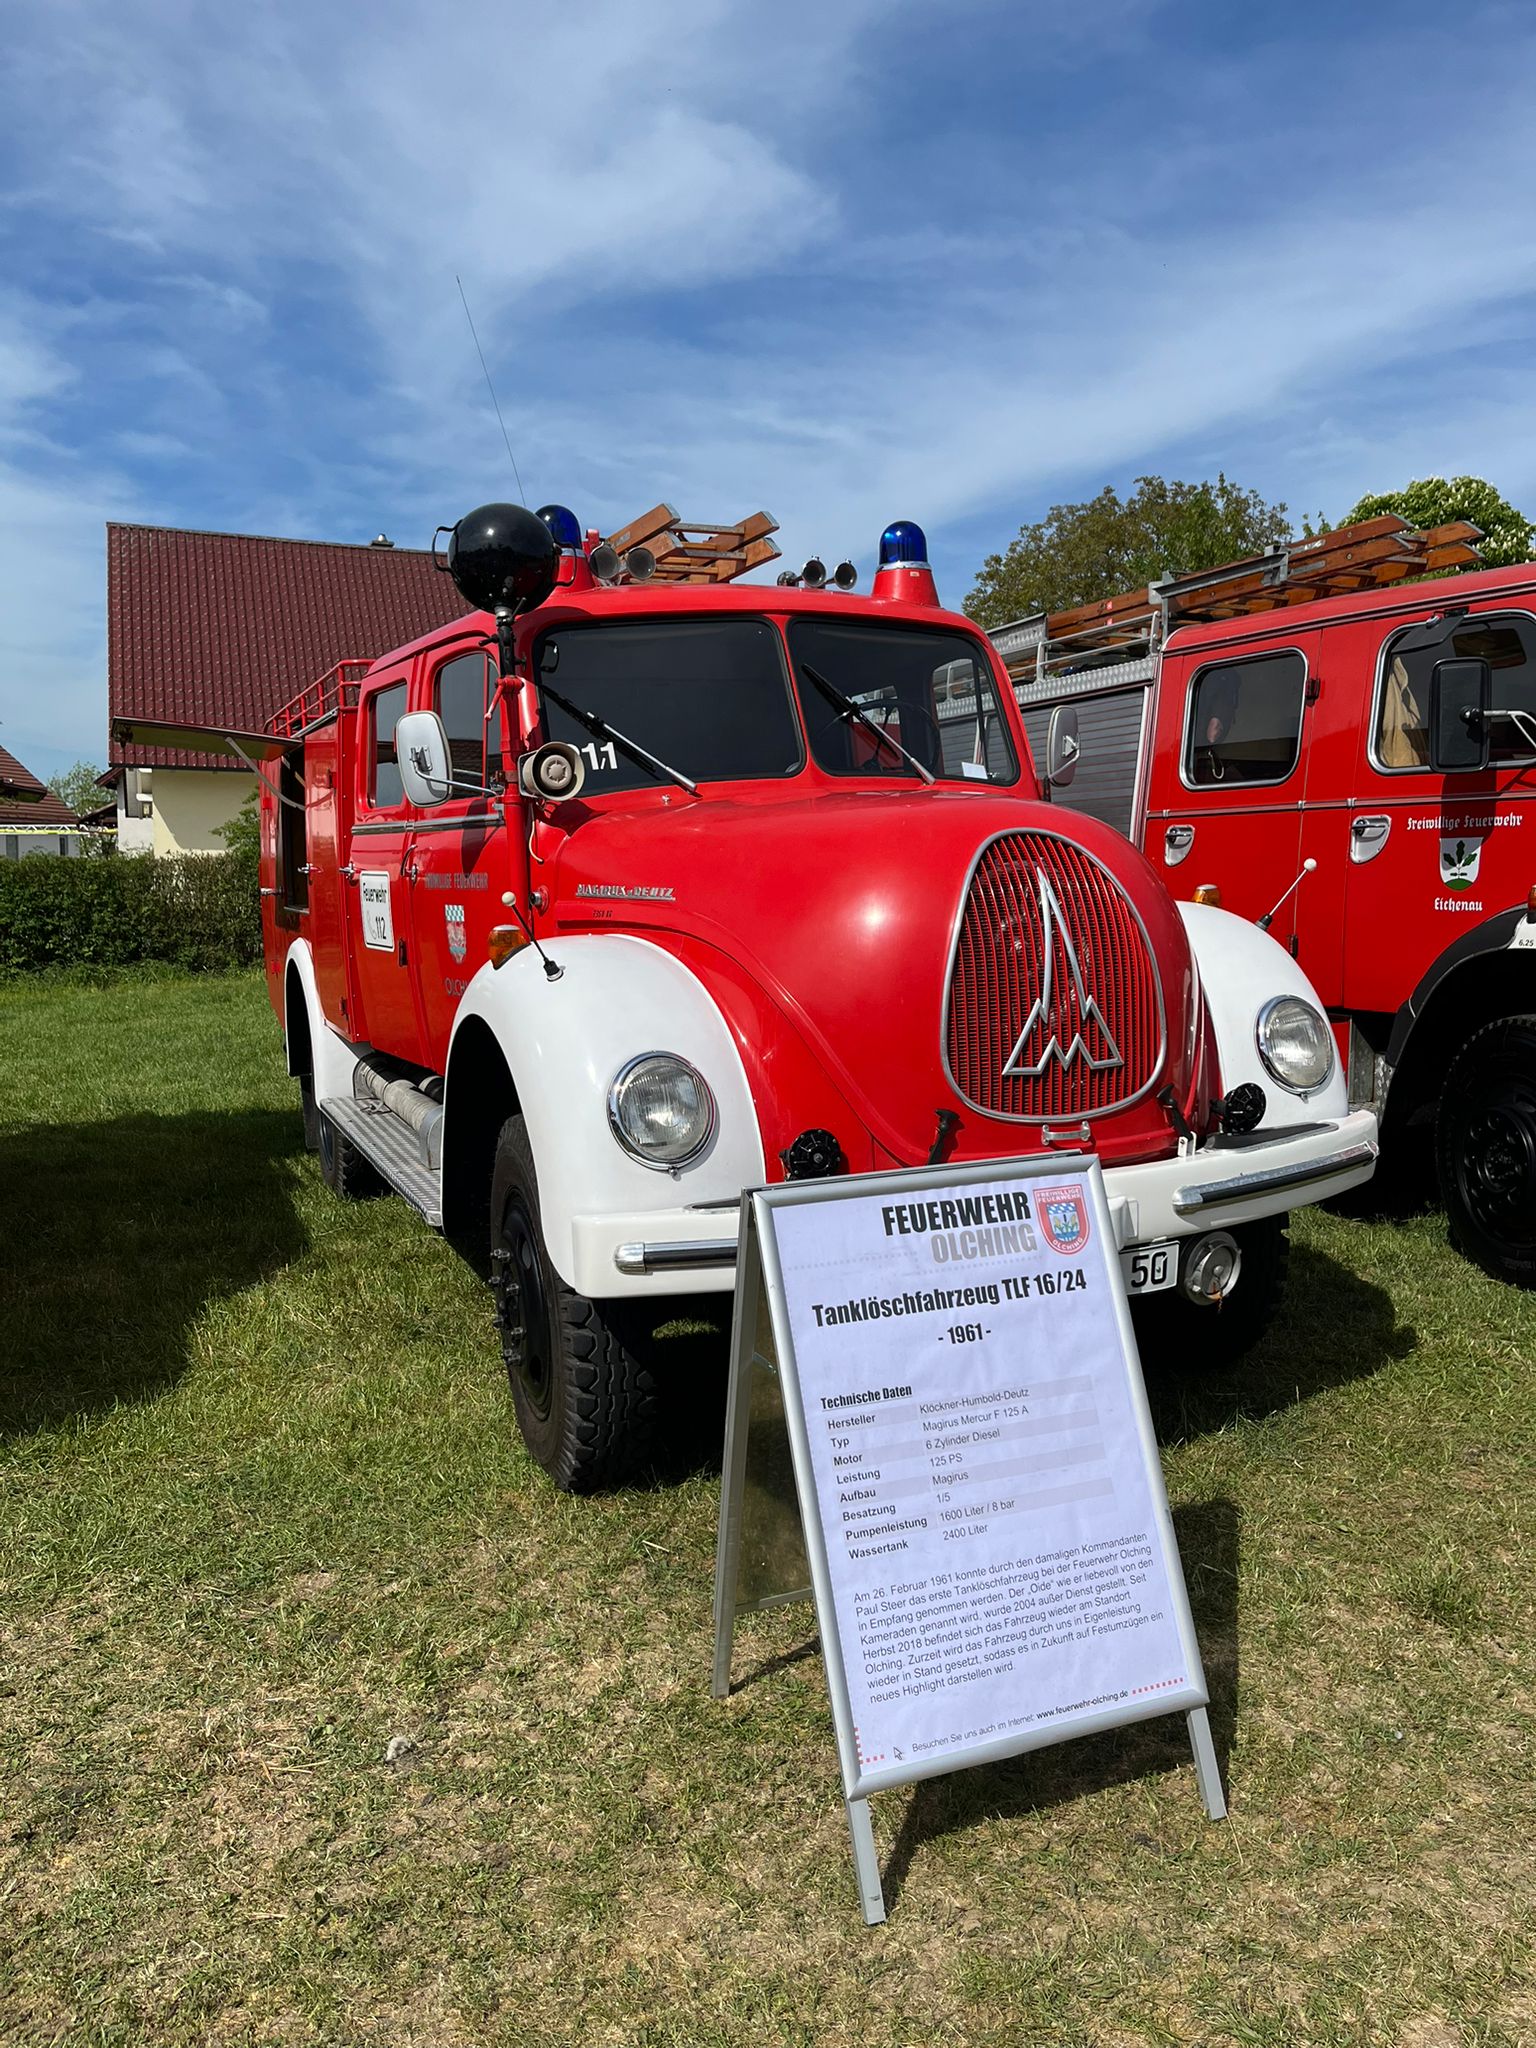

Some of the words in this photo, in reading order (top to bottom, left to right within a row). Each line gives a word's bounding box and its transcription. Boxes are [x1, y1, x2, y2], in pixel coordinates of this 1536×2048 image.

[362, 882, 388, 903] Feuerwehr
[1434, 897, 1483, 912] Eichenau
[375, 915, 387, 940] 112
[881, 1191, 1031, 1236] FEUERWEHR
[930, 1223, 1037, 1263] OLCHING
[1130, 1251, 1168, 1288] 50
[811, 1283, 1000, 1327] Tanklöschfahrzeug
[1001, 1276, 1030, 1300] TLF
[1032, 1268, 1087, 1295] 16/24
[946, 1322, 983, 1344] 1961
[820, 1390, 881, 1409] Technische
[882, 1385, 912, 1399] Daten
[919, 1388, 1029, 1414] Klöckner-Humbold-Deutz
[827, 1414, 875, 1429] Hersteller
[922, 1418, 959, 1431] Magirus
[960, 1412, 991, 1425] Mercur
[993, 1409, 999, 1419] F
[1003, 1406, 1019, 1417] 125
[1021, 1404, 1029, 1414] A
[830, 1437, 849, 1449] Typ
[925, 1439, 932, 1449] 6
[933, 1432, 970, 1449] Zylinder
[971, 1427, 1000, 1441] Diesel
[833, 1454, 862, 1466] Motor
[930, 1455, 947, 1467] 125
[948, 1452, 962, 1464] PS
[836, 1470, 880, 1484] Leistung
[932, 1471, 969, 1485] Magirus
[840, 1489, 876, 1503] Aufbau
[936, 1491, 950, 1503] 1/5
[842, 1504, 896, 1521] Besatzung
[939, 1508, 962, 1521] 1600
[963, 1505, 984, 1517] Liter
[991, 1501, 998, 1511] 8
[999, 1500, 1014, 1510] bar
[845, 1518, 927, 1540] Pumpenleistung
[942, 1526, 966, 1540] 2400
[967, 1524, 987, 1535] Liter
[848, 1539, 908, 1559] Wassertank
[853, 1592, 870, 1603] Am
[890, 1580, 927, 1595] Februar
[930, 1573, 952, 1586] 1961
[954, 1567, 986, 1581] konnte
[988, 1560, 1014, 1574] durch
[1015, 1558, 1033, 1568] den
[1034, 1547, 1080, 1564] damaligen
[1081, 1533, 1147, 1554] Kommandanten
[855, 1603, 878, 1617] Paul
[880, 1599, 906, 1612] Steer
[908, 1595, 926, 1606] das
[928, 1589, 952, 1601] erste
[953, 1570, 1039, 1595] Tanklöschfahrzeug
[1040, 1565, 1055, 1577] bei
[1056, 1563, 1070, 1573] der
[1072, 1552, 1118, 1569] Feuerwehr
[1119, 1545, 1151, 1559] Olching
[857, 1621, 867, 1631] in
[869, 1612, 913, 1629] Empfang
[915, 1600, 968, 1622] genommen
[1008, 1587, 1024, 1598] Der
[1055, 1576, 1071, 1587] wie
[1073, 1574, 1082, 1583] er
[1083, 1565, 1119, 1581] liebevoll
[1120, 1562, 1136, 1572] von
[1137, 1559, 1153, 1569] den
[860, 1626, 917, 1645] Kameraden
[918, 1615, 958, 1635] genannt
[983, 1604, 1011, 1618] wurde
[1013, 1597, 1035, 1611] 2004
[1038, 1592, 1063, 1606] außer
[1065, 1585, 1093, 1599] Dienst
[1129, 1573, 1146, 1584] Seit
[862, 1644, 896, 1660] Herbst
[897, 1637, 922, 1652] 2018
[923, 1629, 962, 1646] befindet
[964, 1624, 983, 1637] sich
[985, 1621, 1002, 1632] das
[1003, 1611, 1046, 1628] Fahrzeug
[1047, 1604, 1076, 1617] wieder
[1078, 1600, 1093, 1610] am
[1094, 1590, 1131, 1607] Standort
[907, 1649, 941, 1665] Zurzeit
[942, 1643, 963, 1656] wird
[964, 1640, 982, 1652] das
[984, 1630, 1027, 1647] Fahrzeug
[1028, 1622, 1054, 1636] durch
[1055, 1619, 1072, 1630] uns
[1073, 1616, 1082, 1625] in
[1083, 1603, 1141, 1624] Eigenleistung
[866, 1674, 900, 1688] wieder
[901, 1671, 911, 1681] in
[913, 1662, 942, 1678] Stand
[983, 1647, 1016, 1662] sodass
[1017, 1644, 1029, 1653] es
[1030, 1640, 1039, 1650] in
[1040, 1631, 1074, 1648] Zukunft
[1075, 1626, 1089, 1639] auf
[1150, 1611, 1163, 1621] ein
[870, 1689, 900, 1703] neues
[902, 1677, 945, 1696] Highlight
[946, 1667, 992, 1685] darstellen
[1035, 1689, 1128, 1719] www.feuerwehr-olching.de
